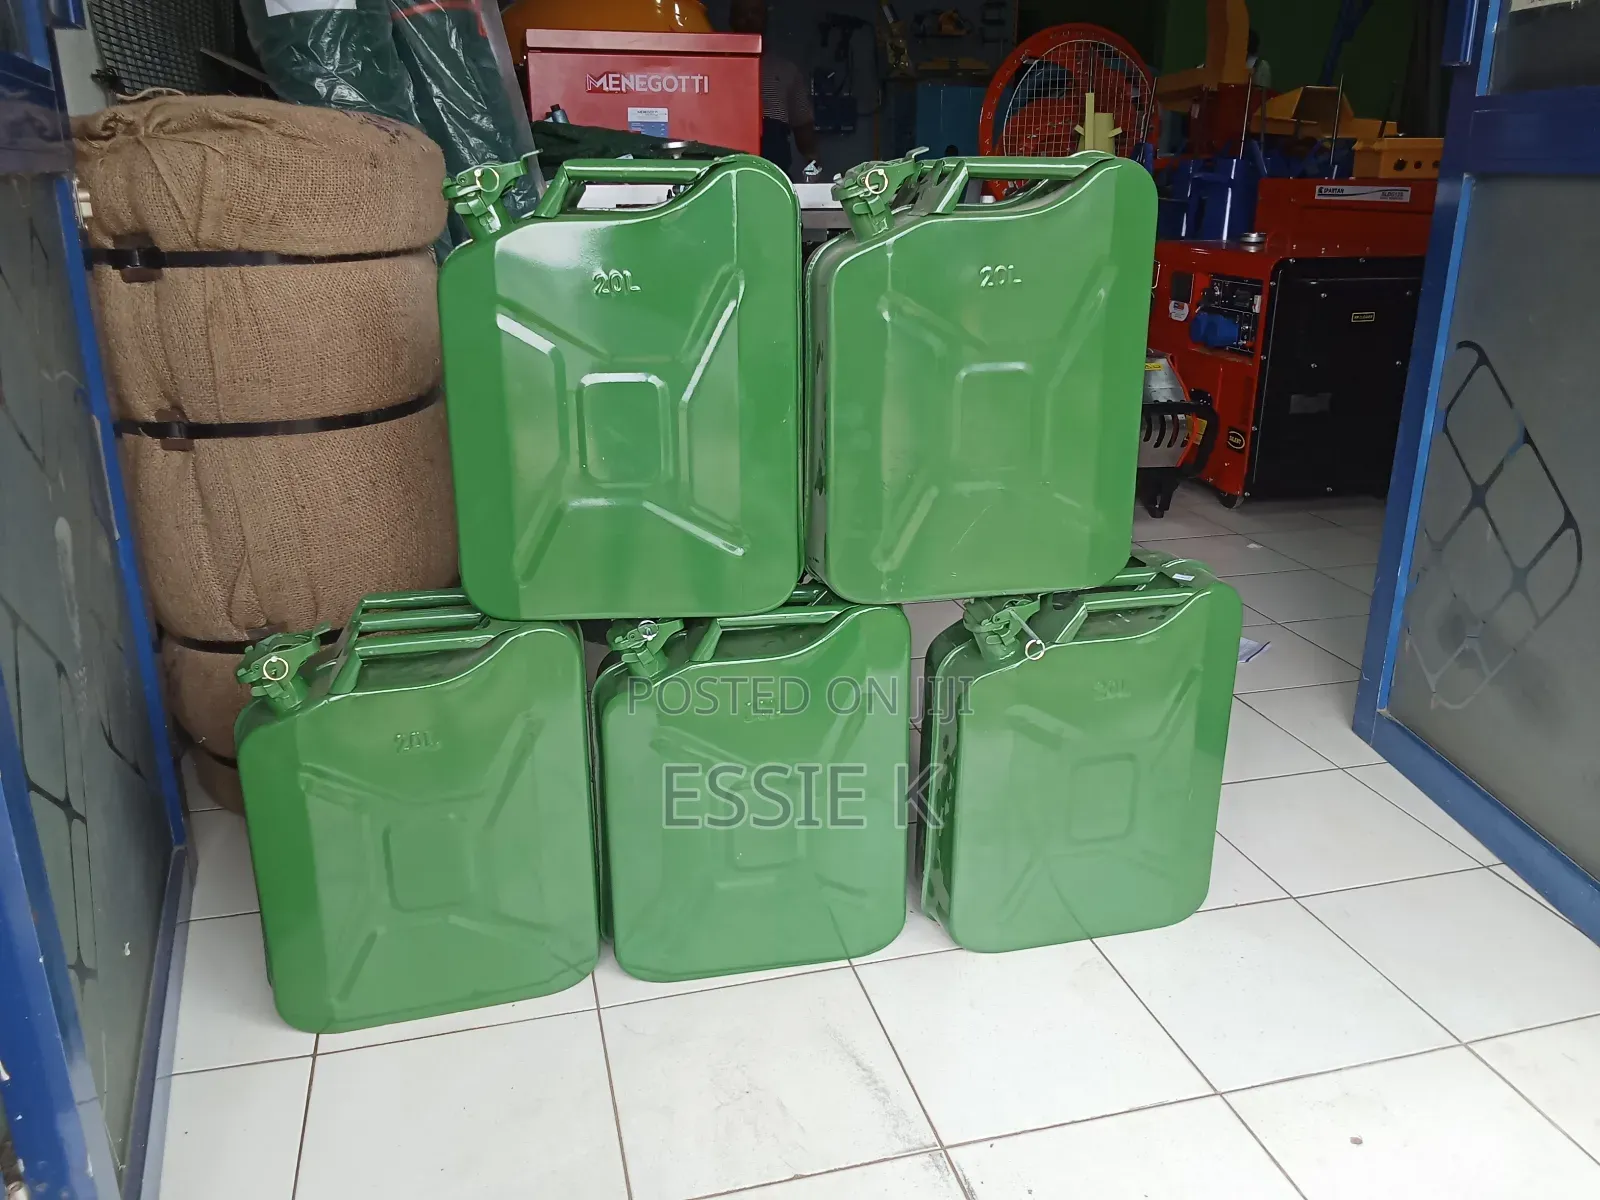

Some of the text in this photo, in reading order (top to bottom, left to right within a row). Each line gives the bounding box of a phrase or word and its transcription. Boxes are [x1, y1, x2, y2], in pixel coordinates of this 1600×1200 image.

[586, 73, 709, 93] MENEGOTTI
[592, 268, 642, 297] 20L
[980, 265, 1022, 287] 20L
